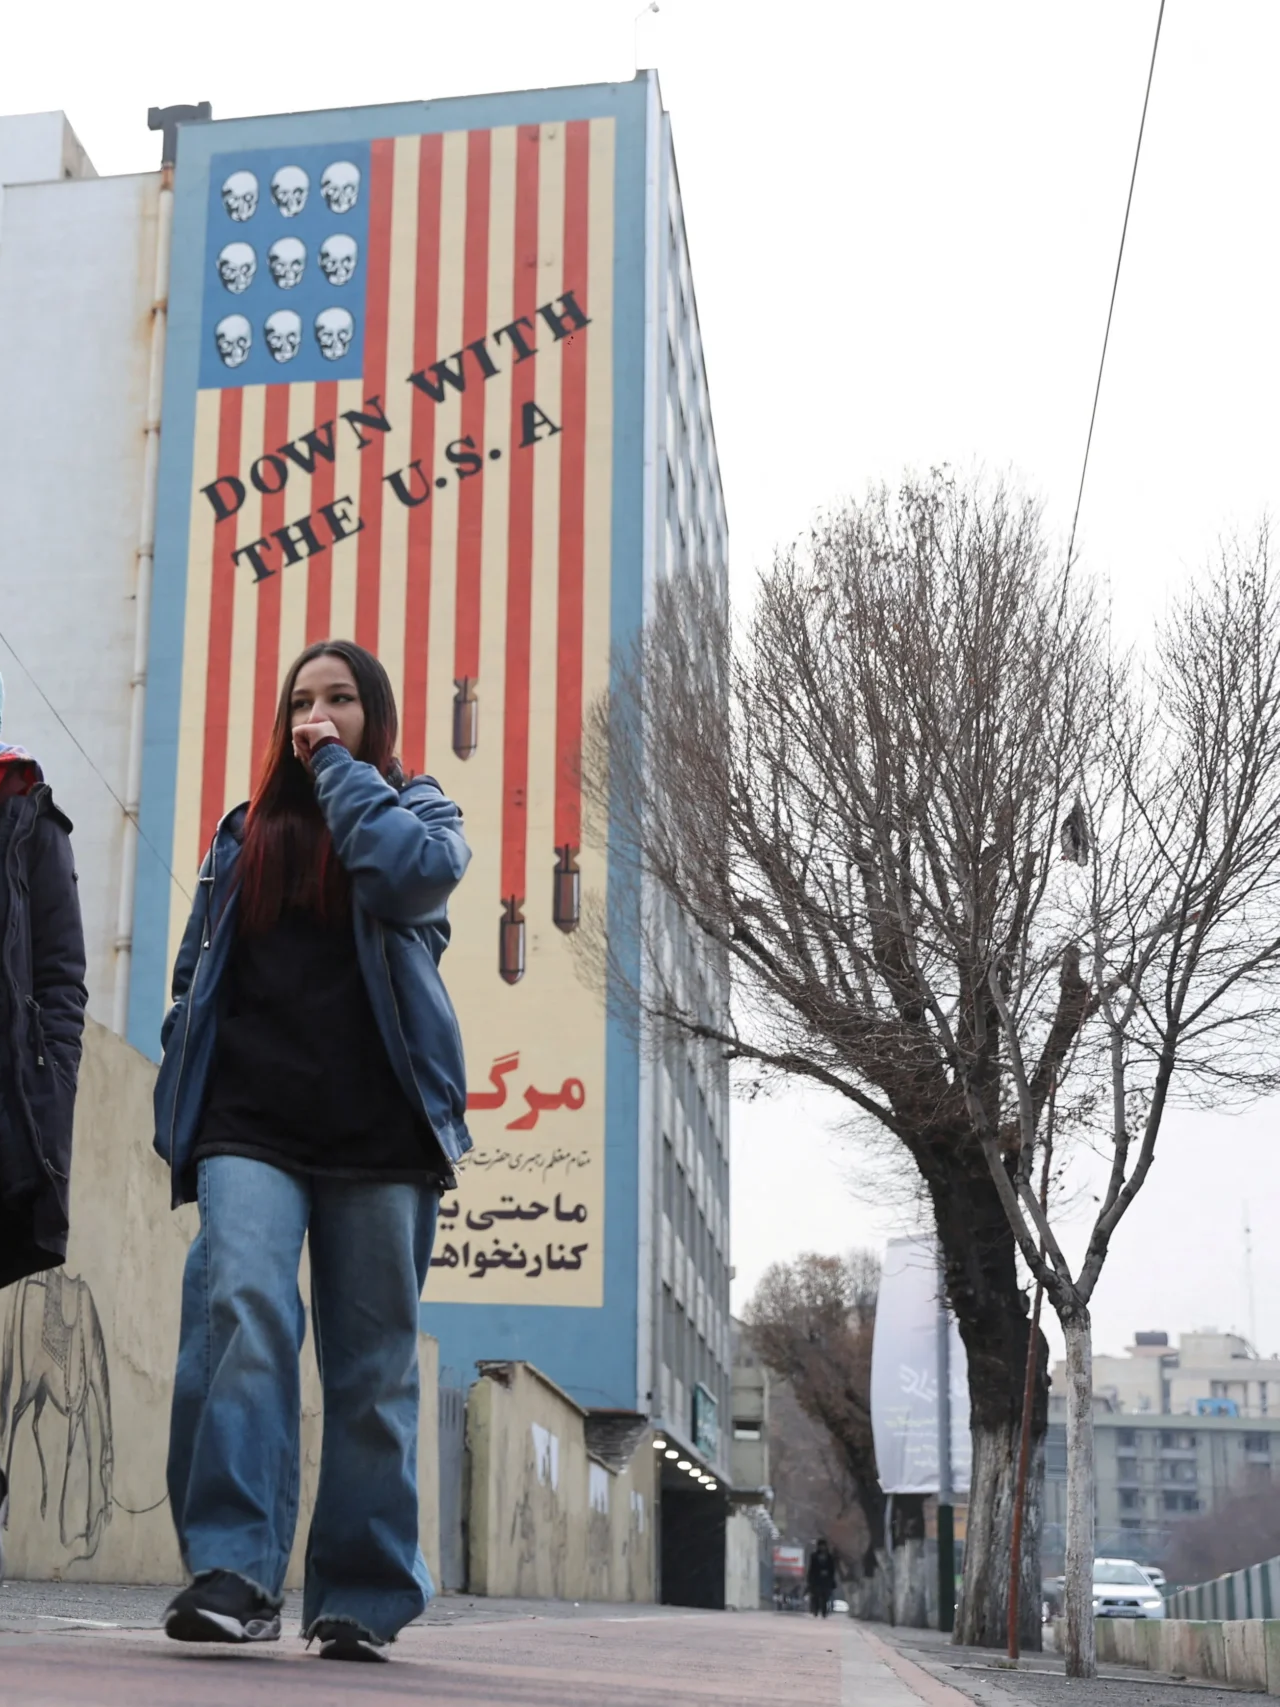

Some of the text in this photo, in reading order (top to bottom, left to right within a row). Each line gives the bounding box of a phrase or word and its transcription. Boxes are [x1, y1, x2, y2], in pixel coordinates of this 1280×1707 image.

[200, 290, 592, 523] DOWN WITH
[231, 496, 365, 583] THE
[466, 1051, 586, 1130] مرگ
[465, 1196, 549, 1230] حتی
[554, 1193, 588, 1223] ما
[430, 1238, 589, 1278] کنار نخواه
